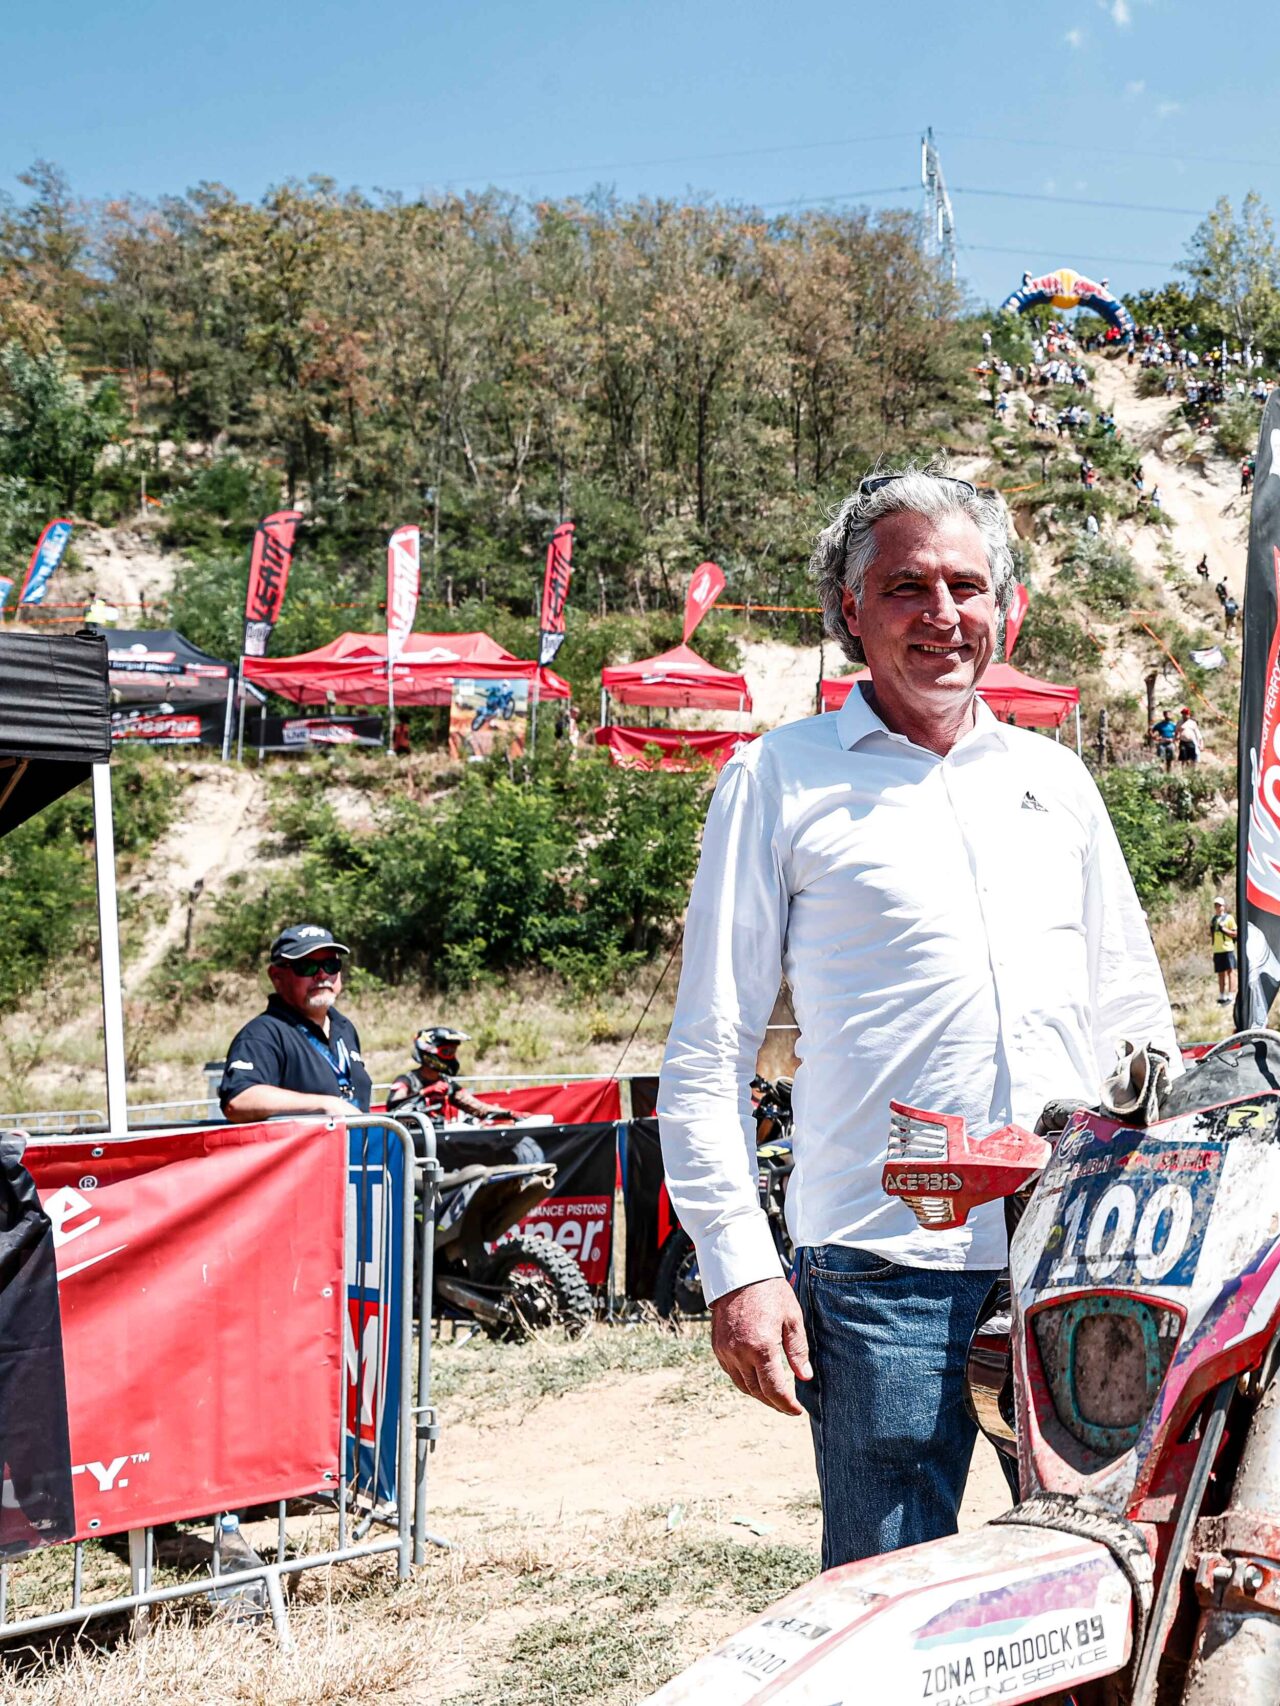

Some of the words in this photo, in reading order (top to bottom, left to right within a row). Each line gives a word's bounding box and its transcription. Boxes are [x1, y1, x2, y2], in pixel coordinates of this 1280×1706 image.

[885, 1172, 963, 1191] ACERBIS
[567, 1203, 607, 1216] PISTONS
[1052, 1184, 1193, 1280] 100
[922, 1656, 976, 1698] ZONA
[984, 1625, 1073, 1678] PADDOCK
[1075, 1614, 1104, 1647] 89
[1022, 1646, 1108, 1686] SERVICE
